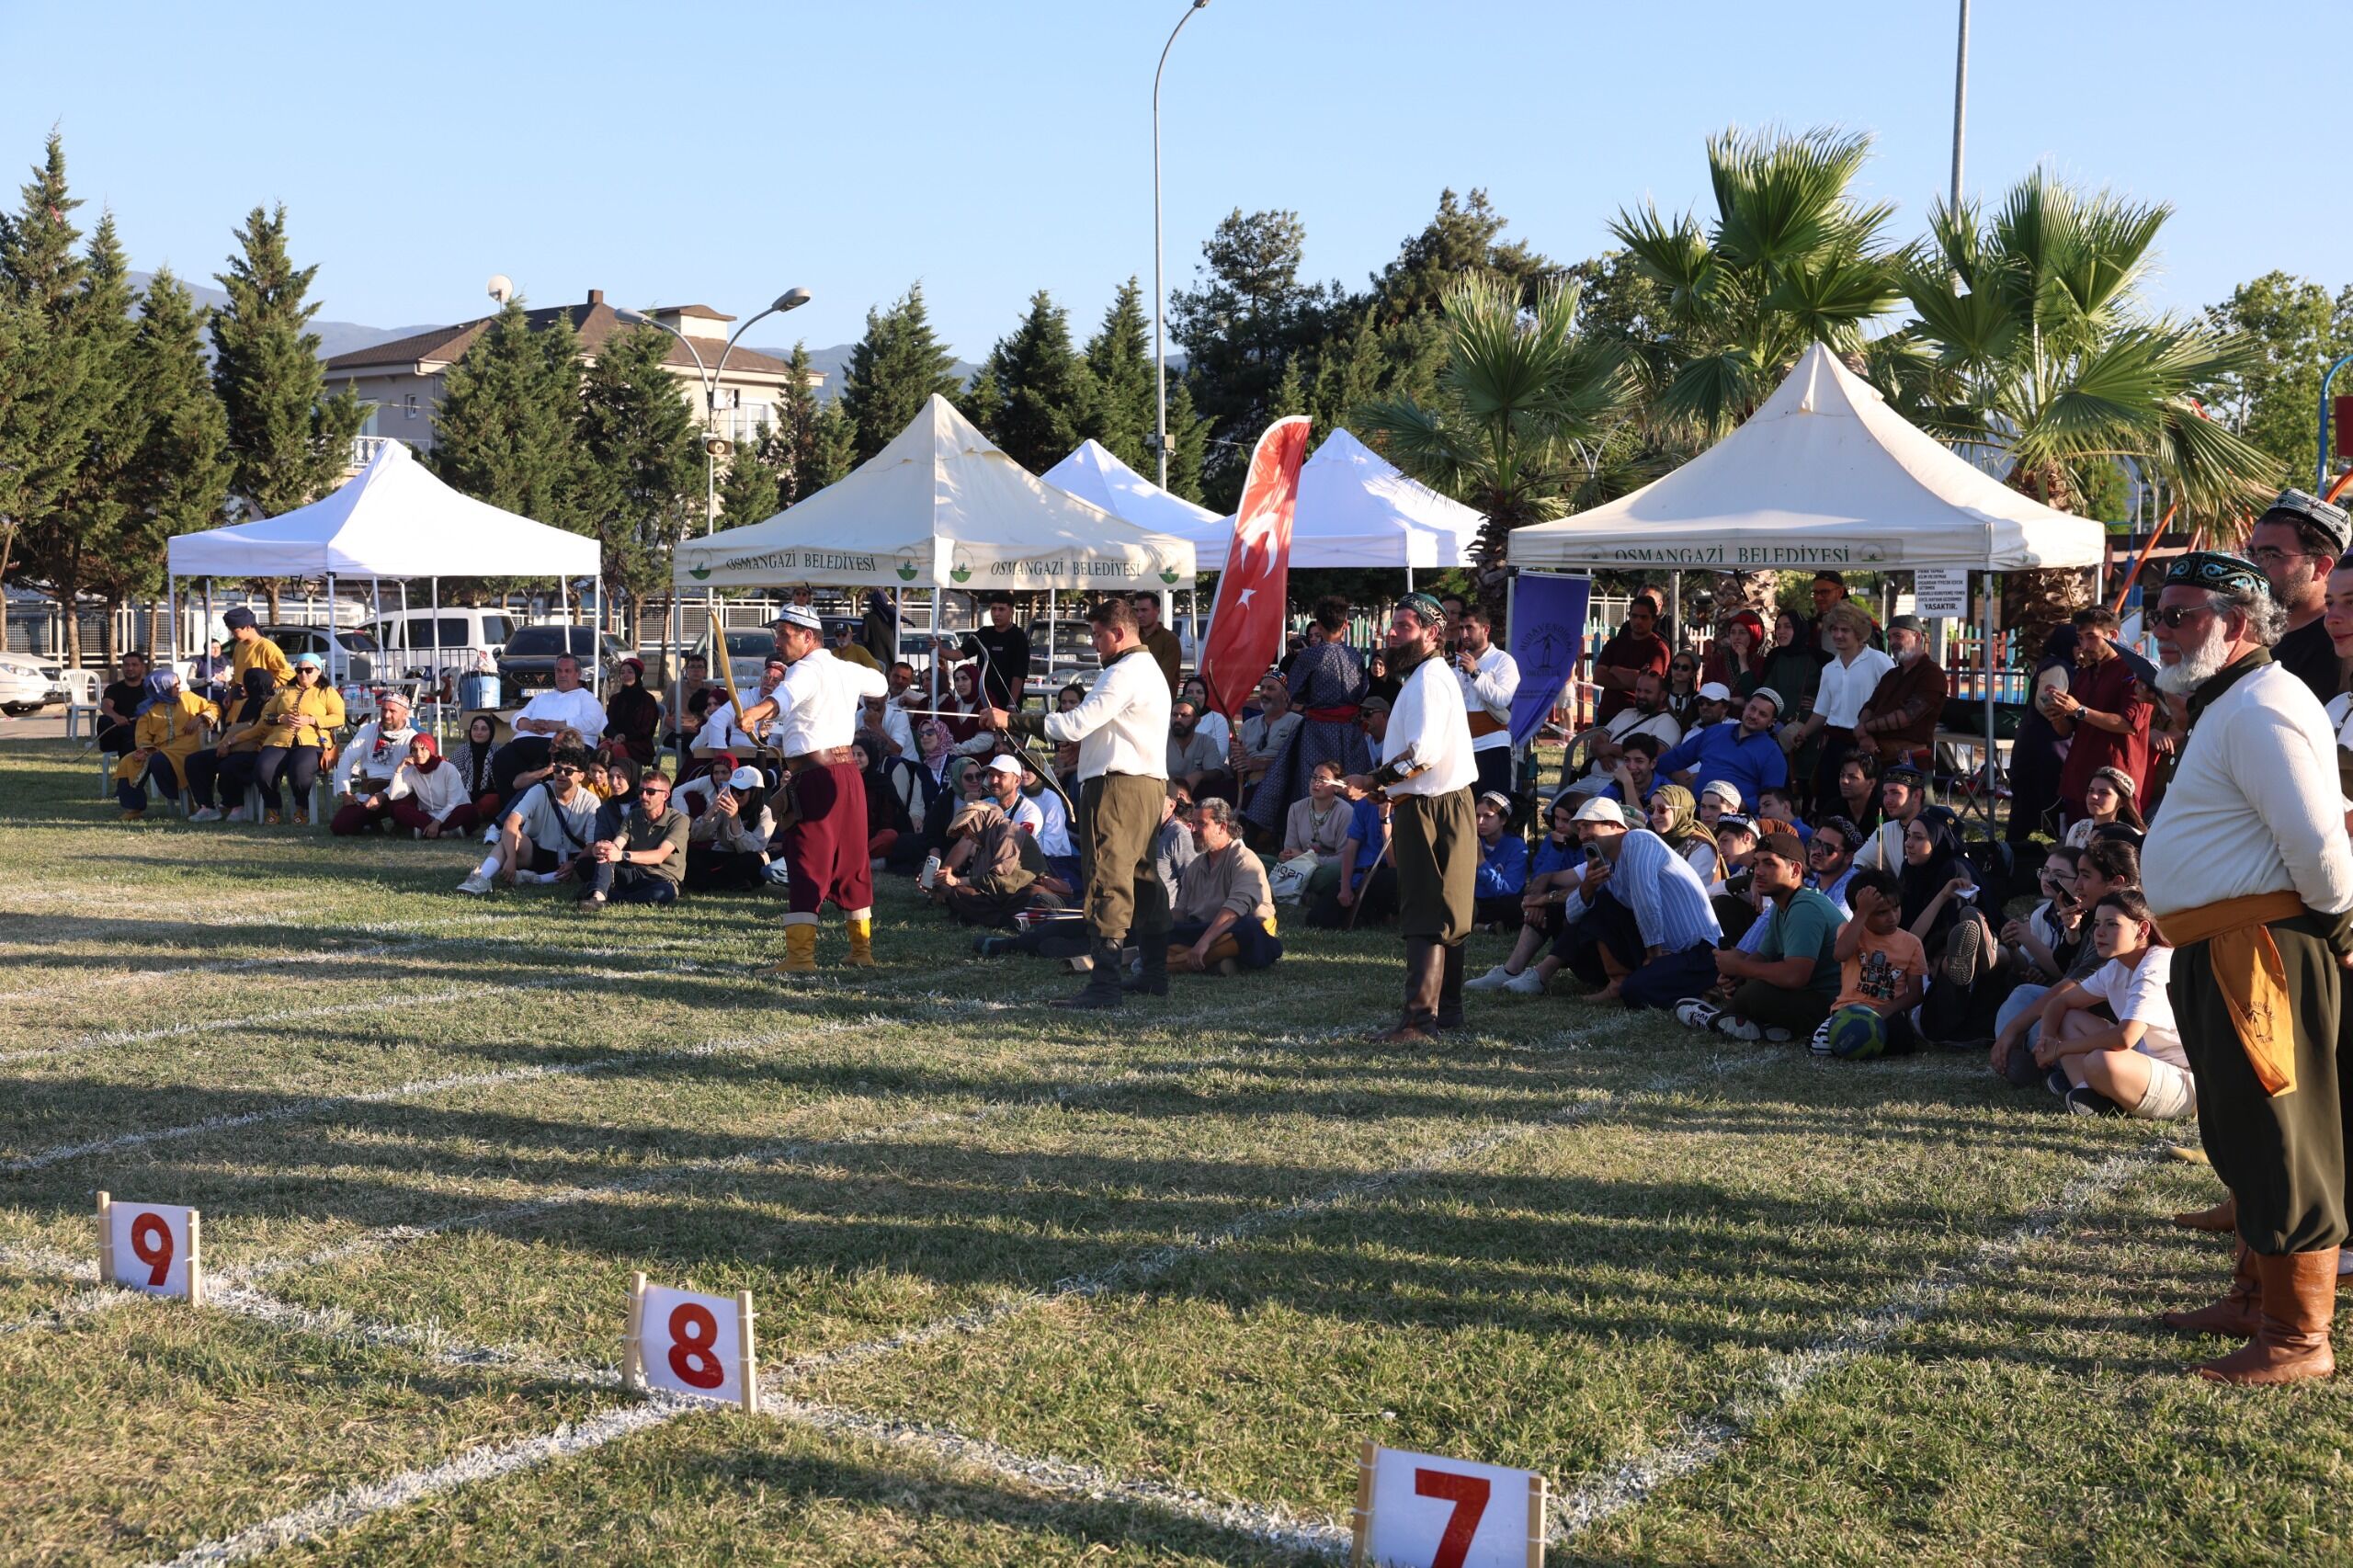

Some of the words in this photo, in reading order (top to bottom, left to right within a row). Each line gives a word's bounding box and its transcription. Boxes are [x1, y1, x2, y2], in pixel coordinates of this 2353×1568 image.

[726, 550, 796, 570] OSMANGAZİ
[804, 552, 877, 572] BELEDİYESİ
[991, 558, 1064, 575] OSMANGAZİ
[1073, 559, 1141, 577] BELEDİYESİ
[1616, 545, 1724, 563] OSMANGAZİ
[1738, 545, 1850, 563] BELEDİYESİ
[131, 1212, 174, 1286] 9
[668, 1302, 724, 1389] 8
[1415, 1468, 1491, 1568] 7
